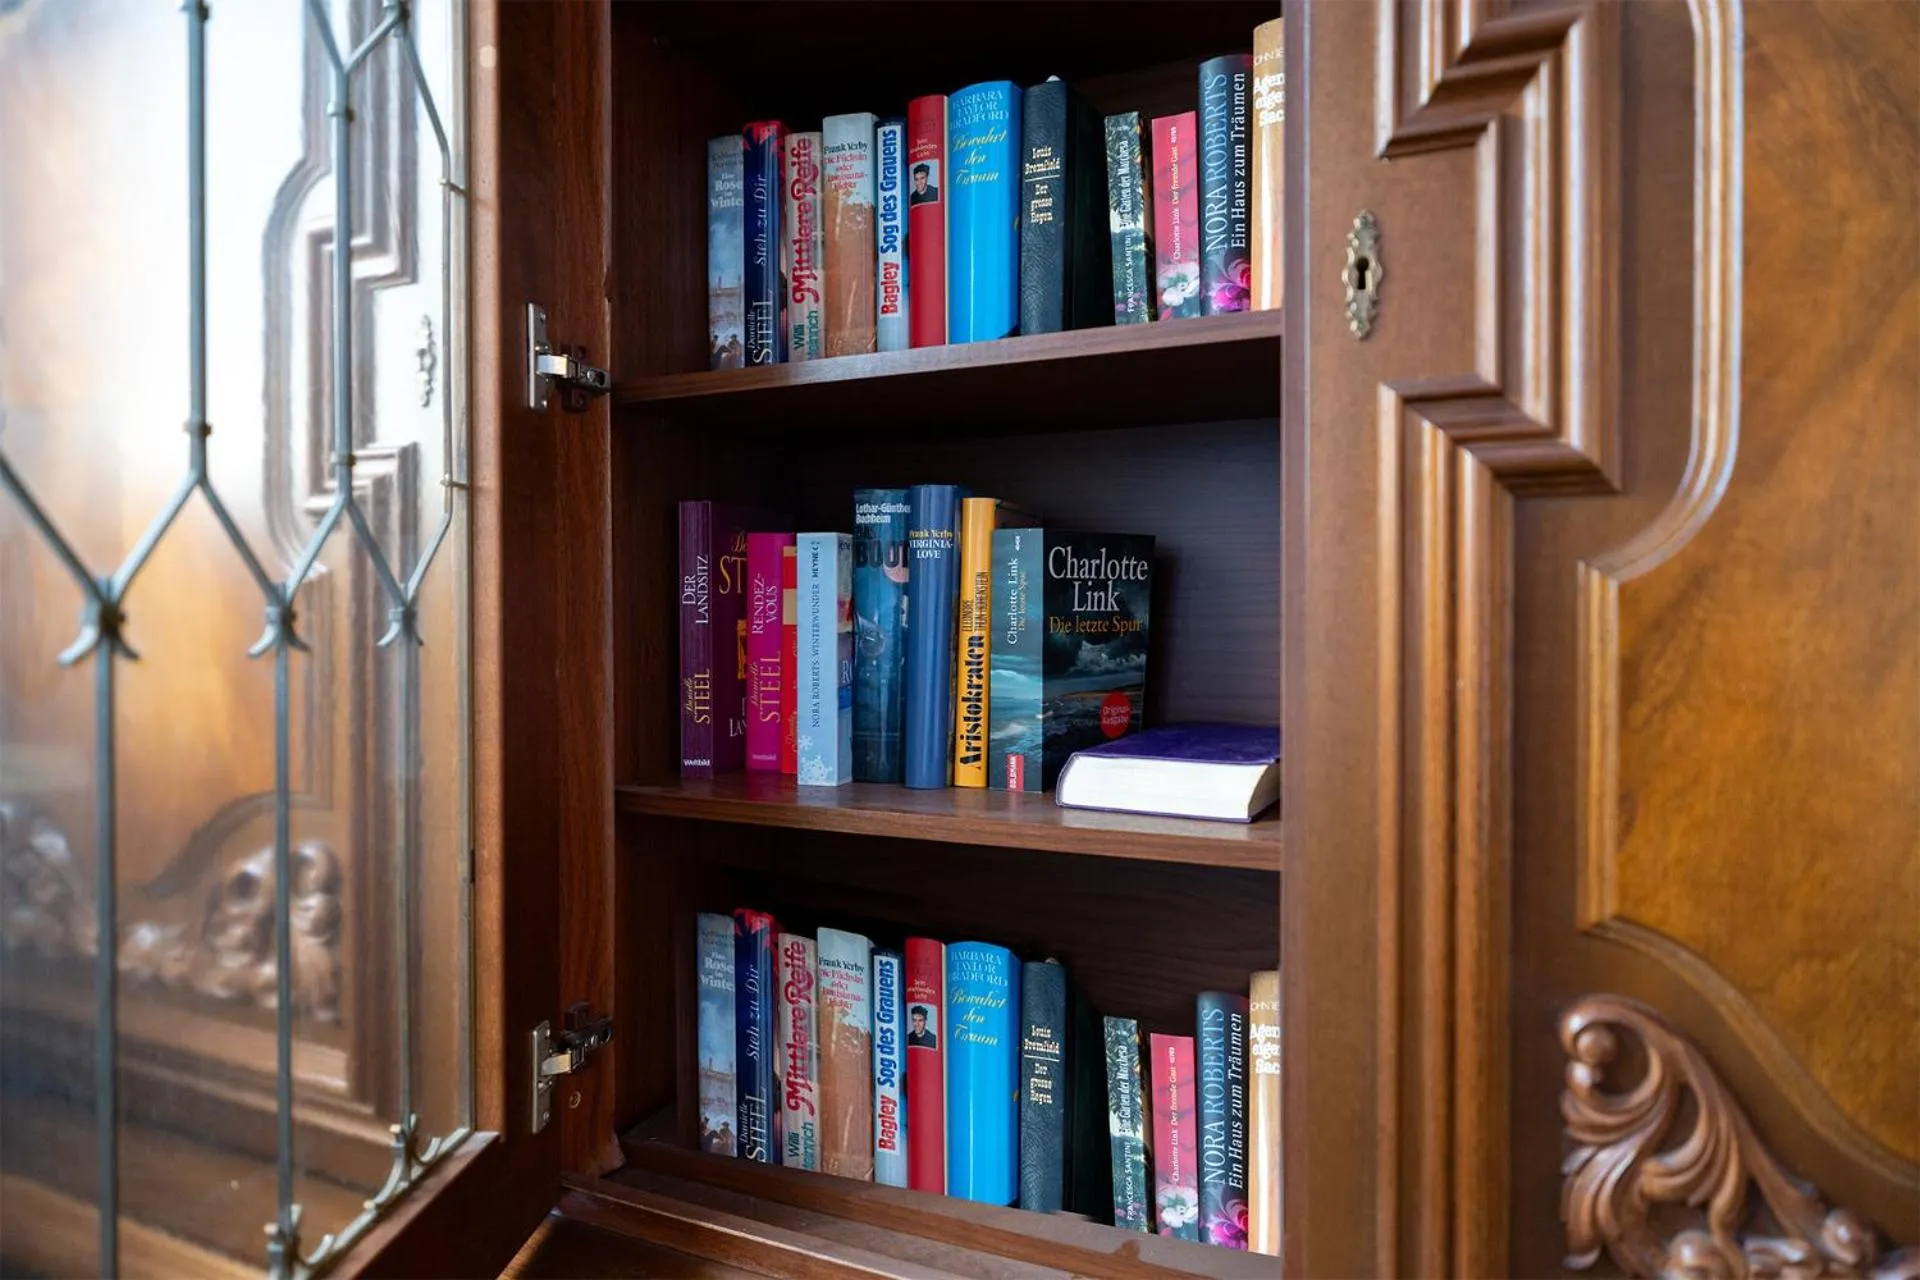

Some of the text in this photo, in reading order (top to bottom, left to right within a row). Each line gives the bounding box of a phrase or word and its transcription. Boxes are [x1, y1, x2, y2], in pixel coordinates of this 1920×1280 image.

[953, 90, 1003, 109] BARBARA
[958, 101, 998, 117] TAYLOR
[824, 141, 868, 154] Frank Yerby
[964, 148, 986, 165] den
[1204, 74, 1228, 253] NORA ROBERTS
[1230, 72, 1246, 248] Ein Haus zum Träumen
[715, 180, 743, 191] Rose
[757, 208, 767, 228] zu
[790, 136, 819, 304] Mittlere Reife
[881, 129, 900, 316] Bagley Sog des Grauens
[1172, 207, 1180, 225] Link
[1125, 235, 1133, 268] SANTINI
[1126, 268, 1135, 313] FRANCESCA
[855, 514, 892, 524] Buchheim
[930, 529, 953, 541] Yerby
[916, 549, 941, 559] LOVE
[1007, 557, 1018, 584] Link
[1048, 546, 1149, 581] Charlotte
[682, 574, 696, 605] DER
[695, 553, 708, 624] LANDSITZ
[752, 573, 765, 635] RENDEZ-
[765, 585, 778, 624] VOUS
[1072, 580, 1121, 613] Link
[1006, 588, 1018, 645] Charlotte
[1049, 615, 1142, 637] Die letzte Spur
[810, 583, 821, 728] NORA ROBERTS WINTERWUNDER
[694, 668, 711, 725] STEEL
[760, 651, 782, 724] STEEL
[959, 635, 985, 771] Aristokraten
[705, 957, 734, 974] Rose
[819, 956, 864, 975] Frank Yerby
[951, 949, 1002, 966] BARBARA
[955, 961, 997, 974] TAYLOR
[749, 1001, 760, 1021] zu
[962, 1006, 986, 1025] den
[784, 940, 815, 1117] Mittlere Reife
[877, 960, 898, 1152] Bagley Sog des Grauens
[1202, 1008, 1226, 1185] NORA ROBERTS
[1227, 1013, 1243, 1189] Ein Haus zum Träumen
[745, 1086, 767, 1164] STEEL
[1171, 1129, 1179, 1145] Link
[1124, 1141, 1132, 1174] SANTINI
[1125, 1176, 1135, 1221] FRANCESCA
